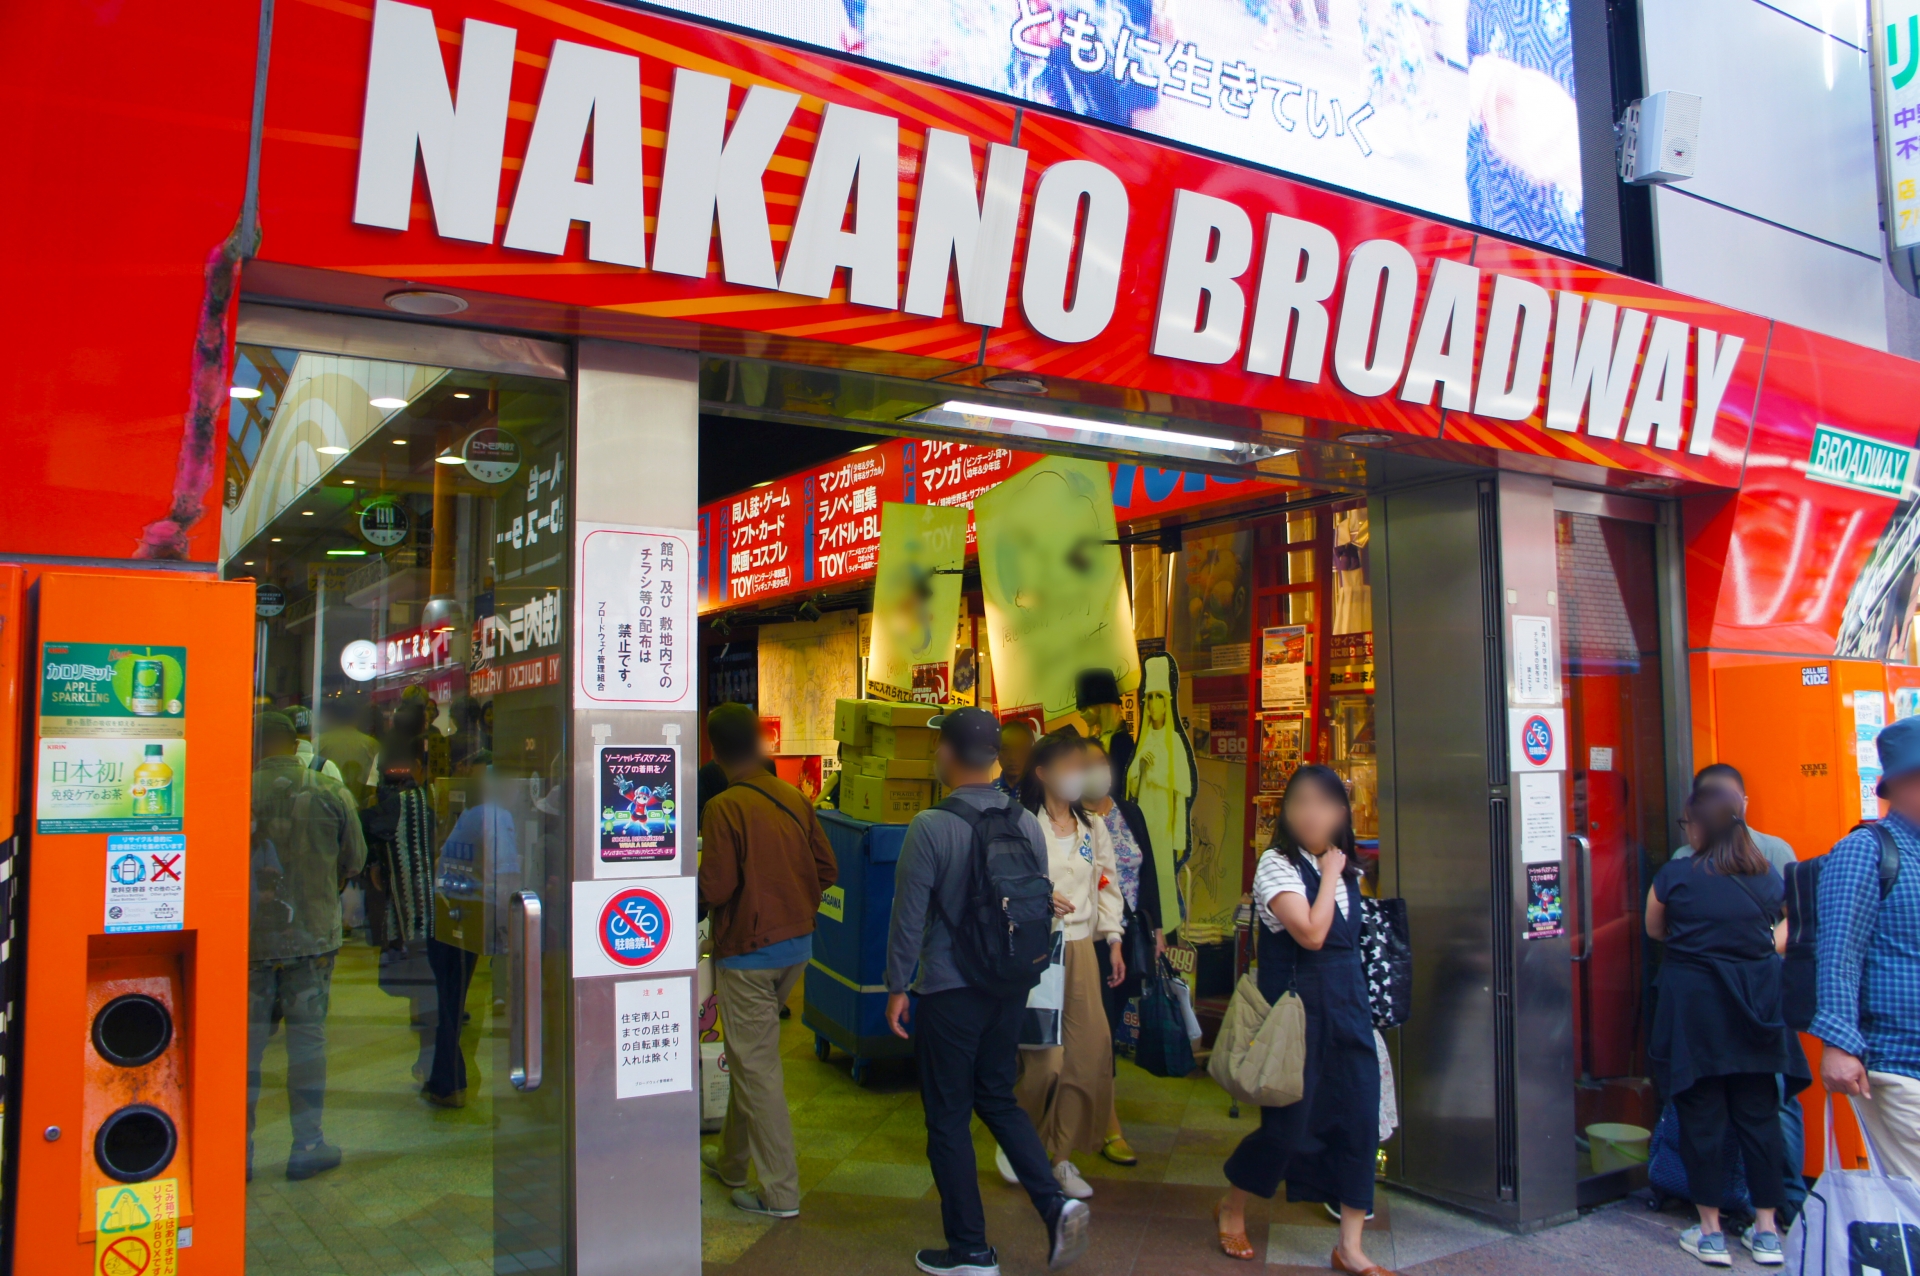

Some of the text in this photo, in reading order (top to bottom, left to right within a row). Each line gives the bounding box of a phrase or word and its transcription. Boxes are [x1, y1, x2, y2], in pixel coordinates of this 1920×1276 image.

[1010, 0, 1375, 157] ともに生きていく
[1894, 104, 1920, 129] 中
[1895, 135, 1920, 160] 不
[353, 0, 1744, 457] NAKANO BROADWAY
[1817, 433, 1906, 489] BROADWAY
[819, 462, 851, 494] マンガ
[921, 457, 962, 493] マンガ
[731, 486, 791, 523] 同人誌・ゲーム
[819, 485, 877, 523] ラノベ・画集
[732, 514, 785, 549] ソフト・カード
[818, 514, 881, 550] アイドル・BL
[731, 541, 788, 574] 映画・コスプレ
[818, 554, 846, 578] TOY
[731, 576, 752, 599] TOY
[638, 547, 653, 663] チラシ等の配布は
[659, 541, 674, 688] 館内 及び 敷地内での
[596, 601, 607, 691] ブロードウェイ管理組合
[617, 623, 632, 689] 禁止です。
[46, 662, 117, 682] カロリミット
[1801, 667, 1818, 675] CALL
[1802, 673, 1829, 685] KIDZ
[52, 692, 110, 703] SPARKLING
[64, 682, 98, 693] APPLE
[1217, 737, 1248, 753] 960
[604, 752, 672, 764] ソーシャルディスタンスと
[51, 788, 123, 801] 免疫ケアのお茶
[617, 811, 629, 819] 2m
[614, 936, 656, 951] 駐輪禁止
[621, 1010, 670, 1024] 住宅南入口
[621, 1022, 680, 1038] までの居住者
[621, 1036, 680, 1052] の自転車乗り
